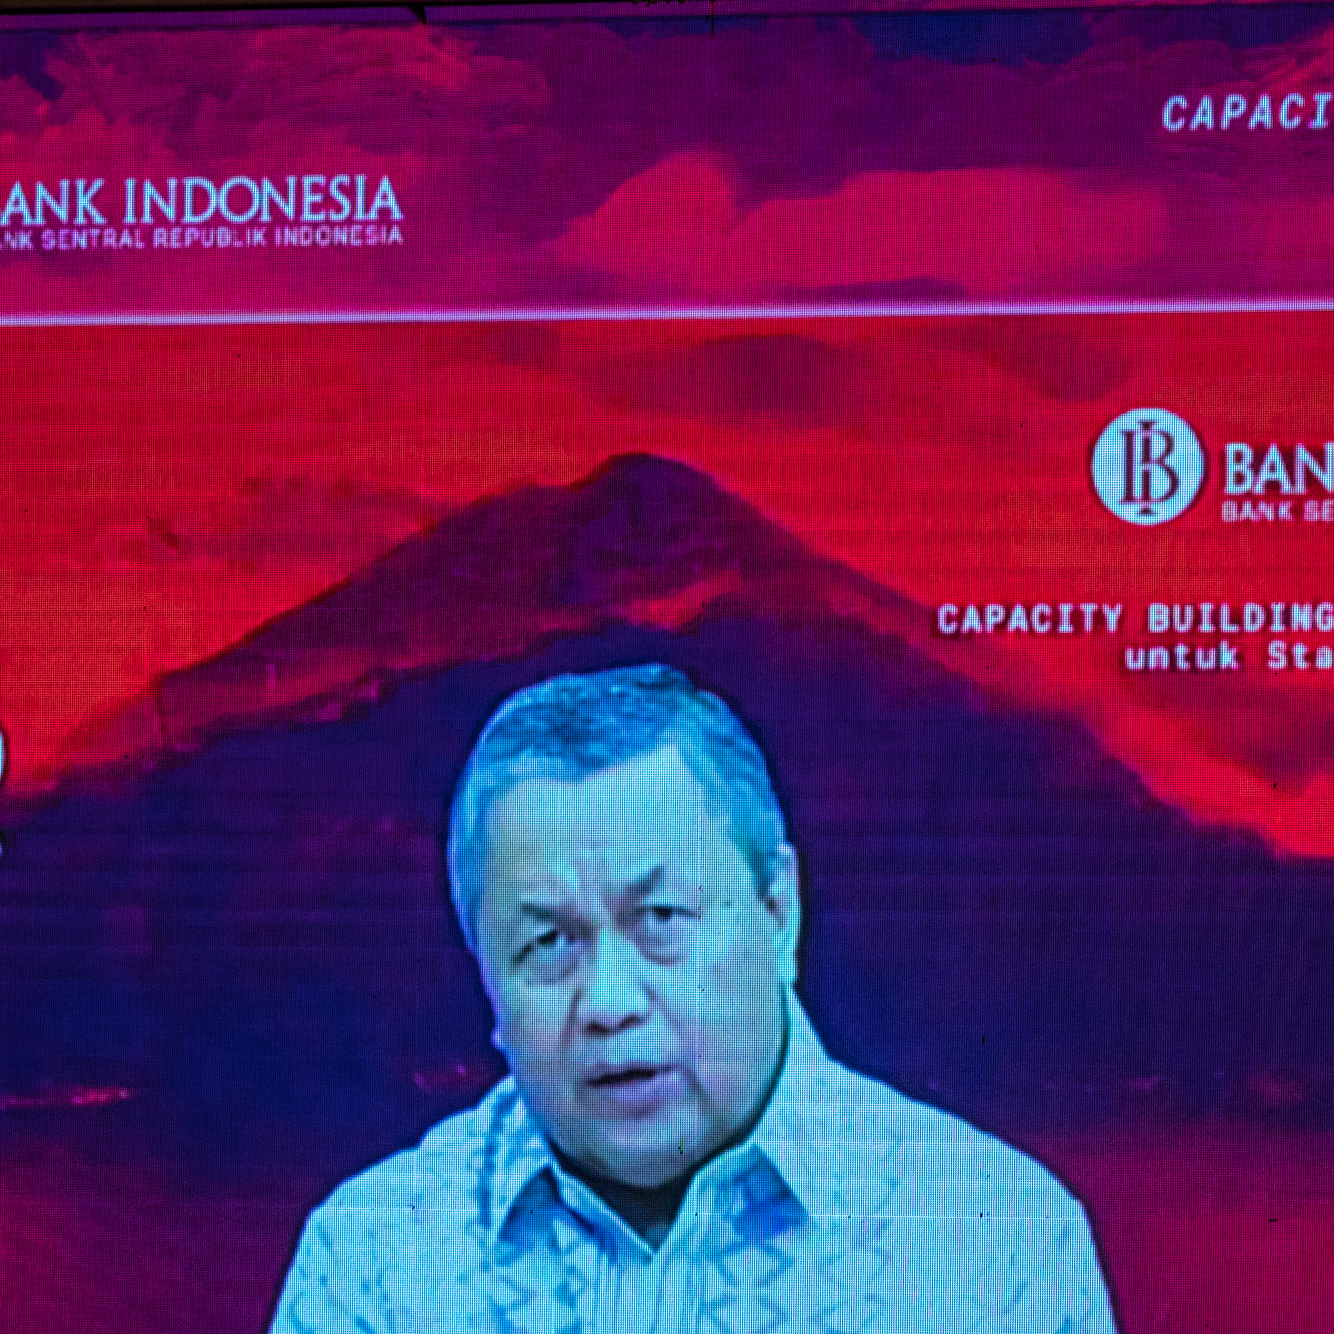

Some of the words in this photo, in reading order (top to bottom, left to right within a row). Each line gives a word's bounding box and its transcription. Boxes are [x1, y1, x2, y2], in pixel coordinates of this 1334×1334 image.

[124, 174, 402, 224] INDONESIA
[40, 228, 144, 250] SENTRAL
[153, 226, 265, 248] REPUBLIK
[275, 224, 403, 246] INDONESIA
[1221, 501, 1290, 522] BANK
[939, 603, 1121, 633] CAPACITY
[1148, 603, 1334, 633] BUILDING
[1126, 641, 1237, 669] untuk
